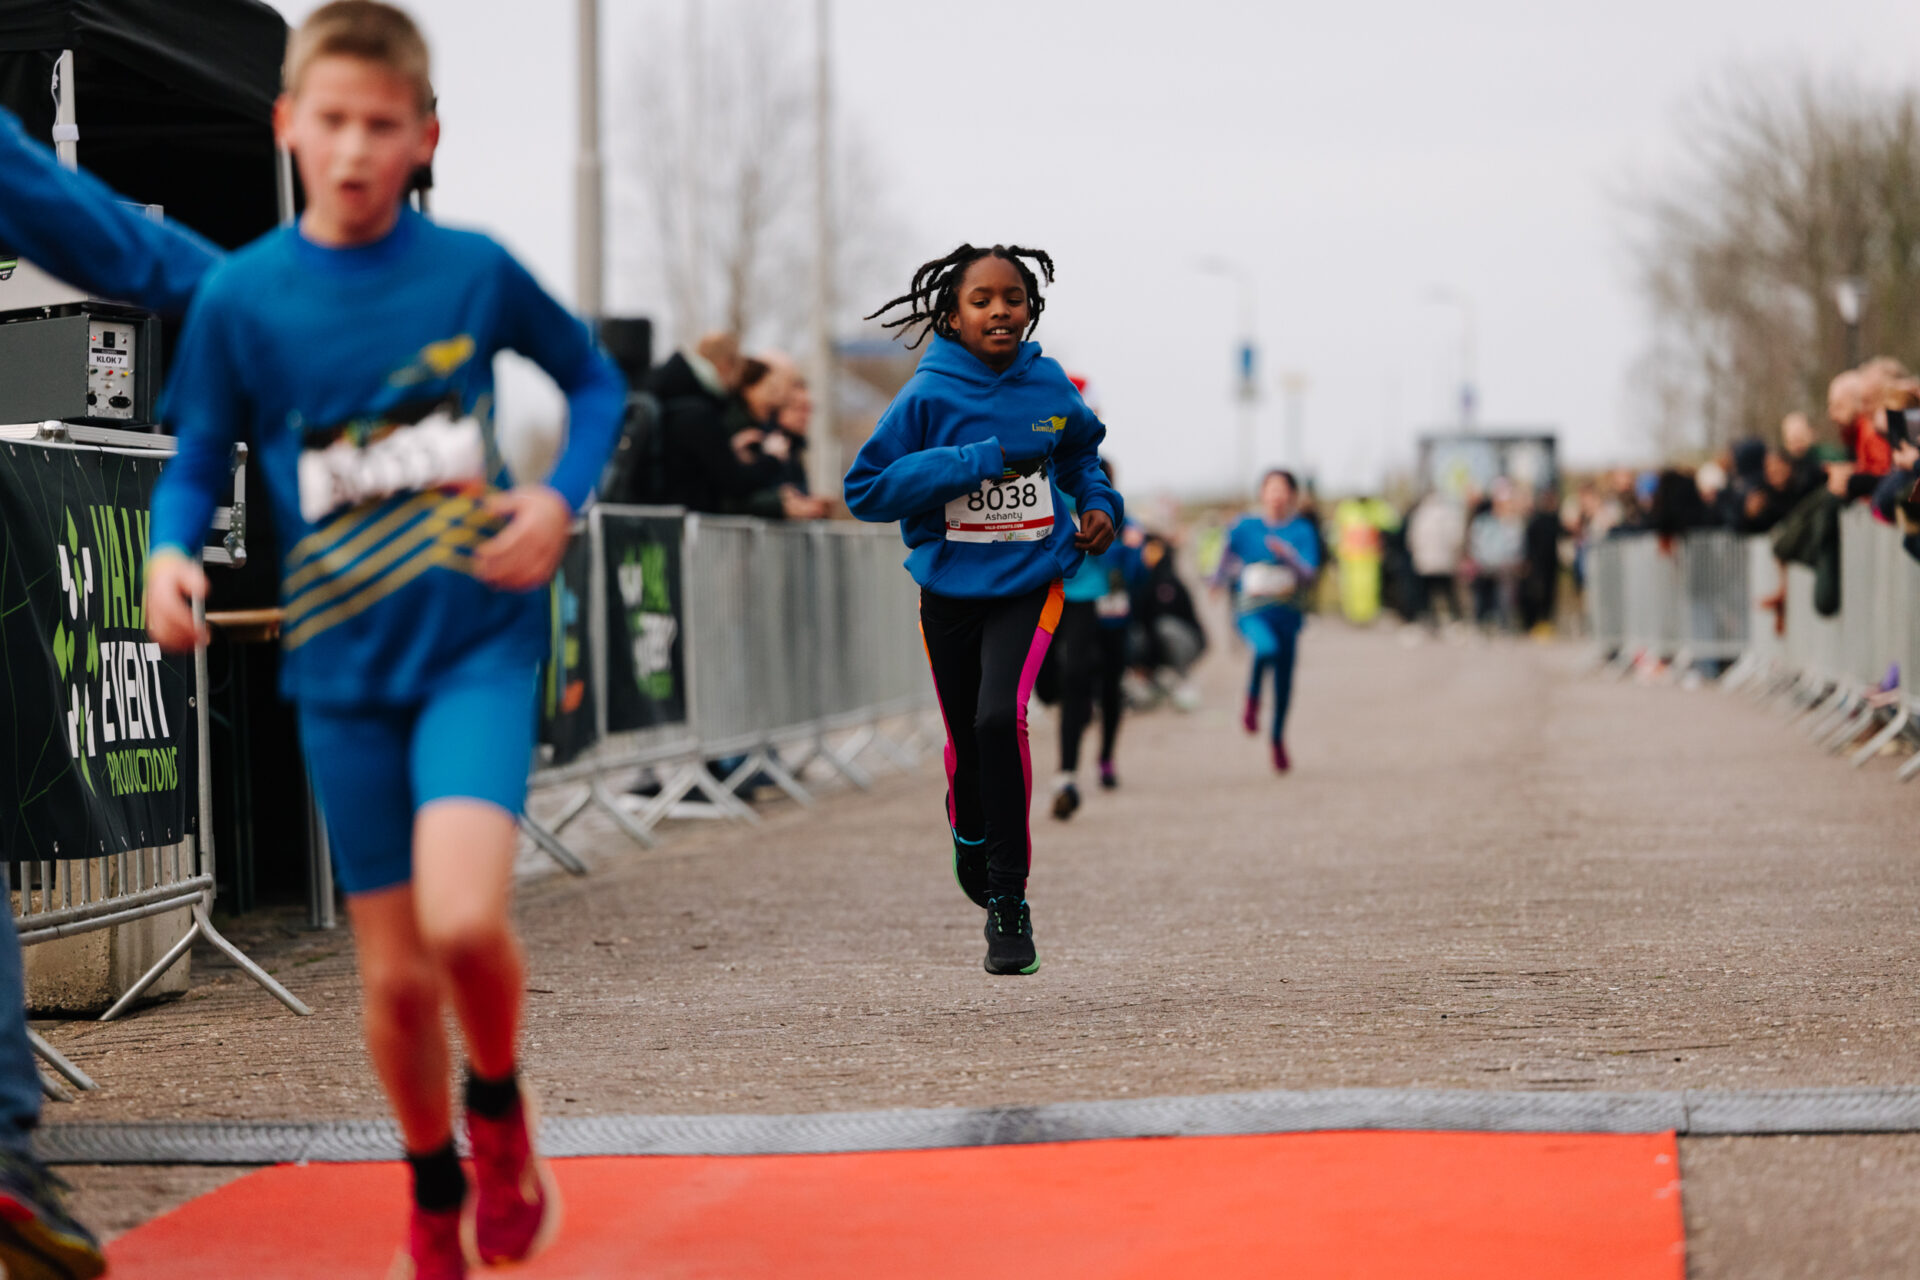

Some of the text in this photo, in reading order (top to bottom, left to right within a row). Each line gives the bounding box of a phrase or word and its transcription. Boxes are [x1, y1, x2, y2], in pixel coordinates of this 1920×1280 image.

[96, 355, 117, 364] KLOK
[967, 483, 1037, 511] 8038
[985, 512, 1023, 520] Ashanty
[100, 641, 170, 742] EVENT
[106, 746, 178, 796] PRODUCTIONS
